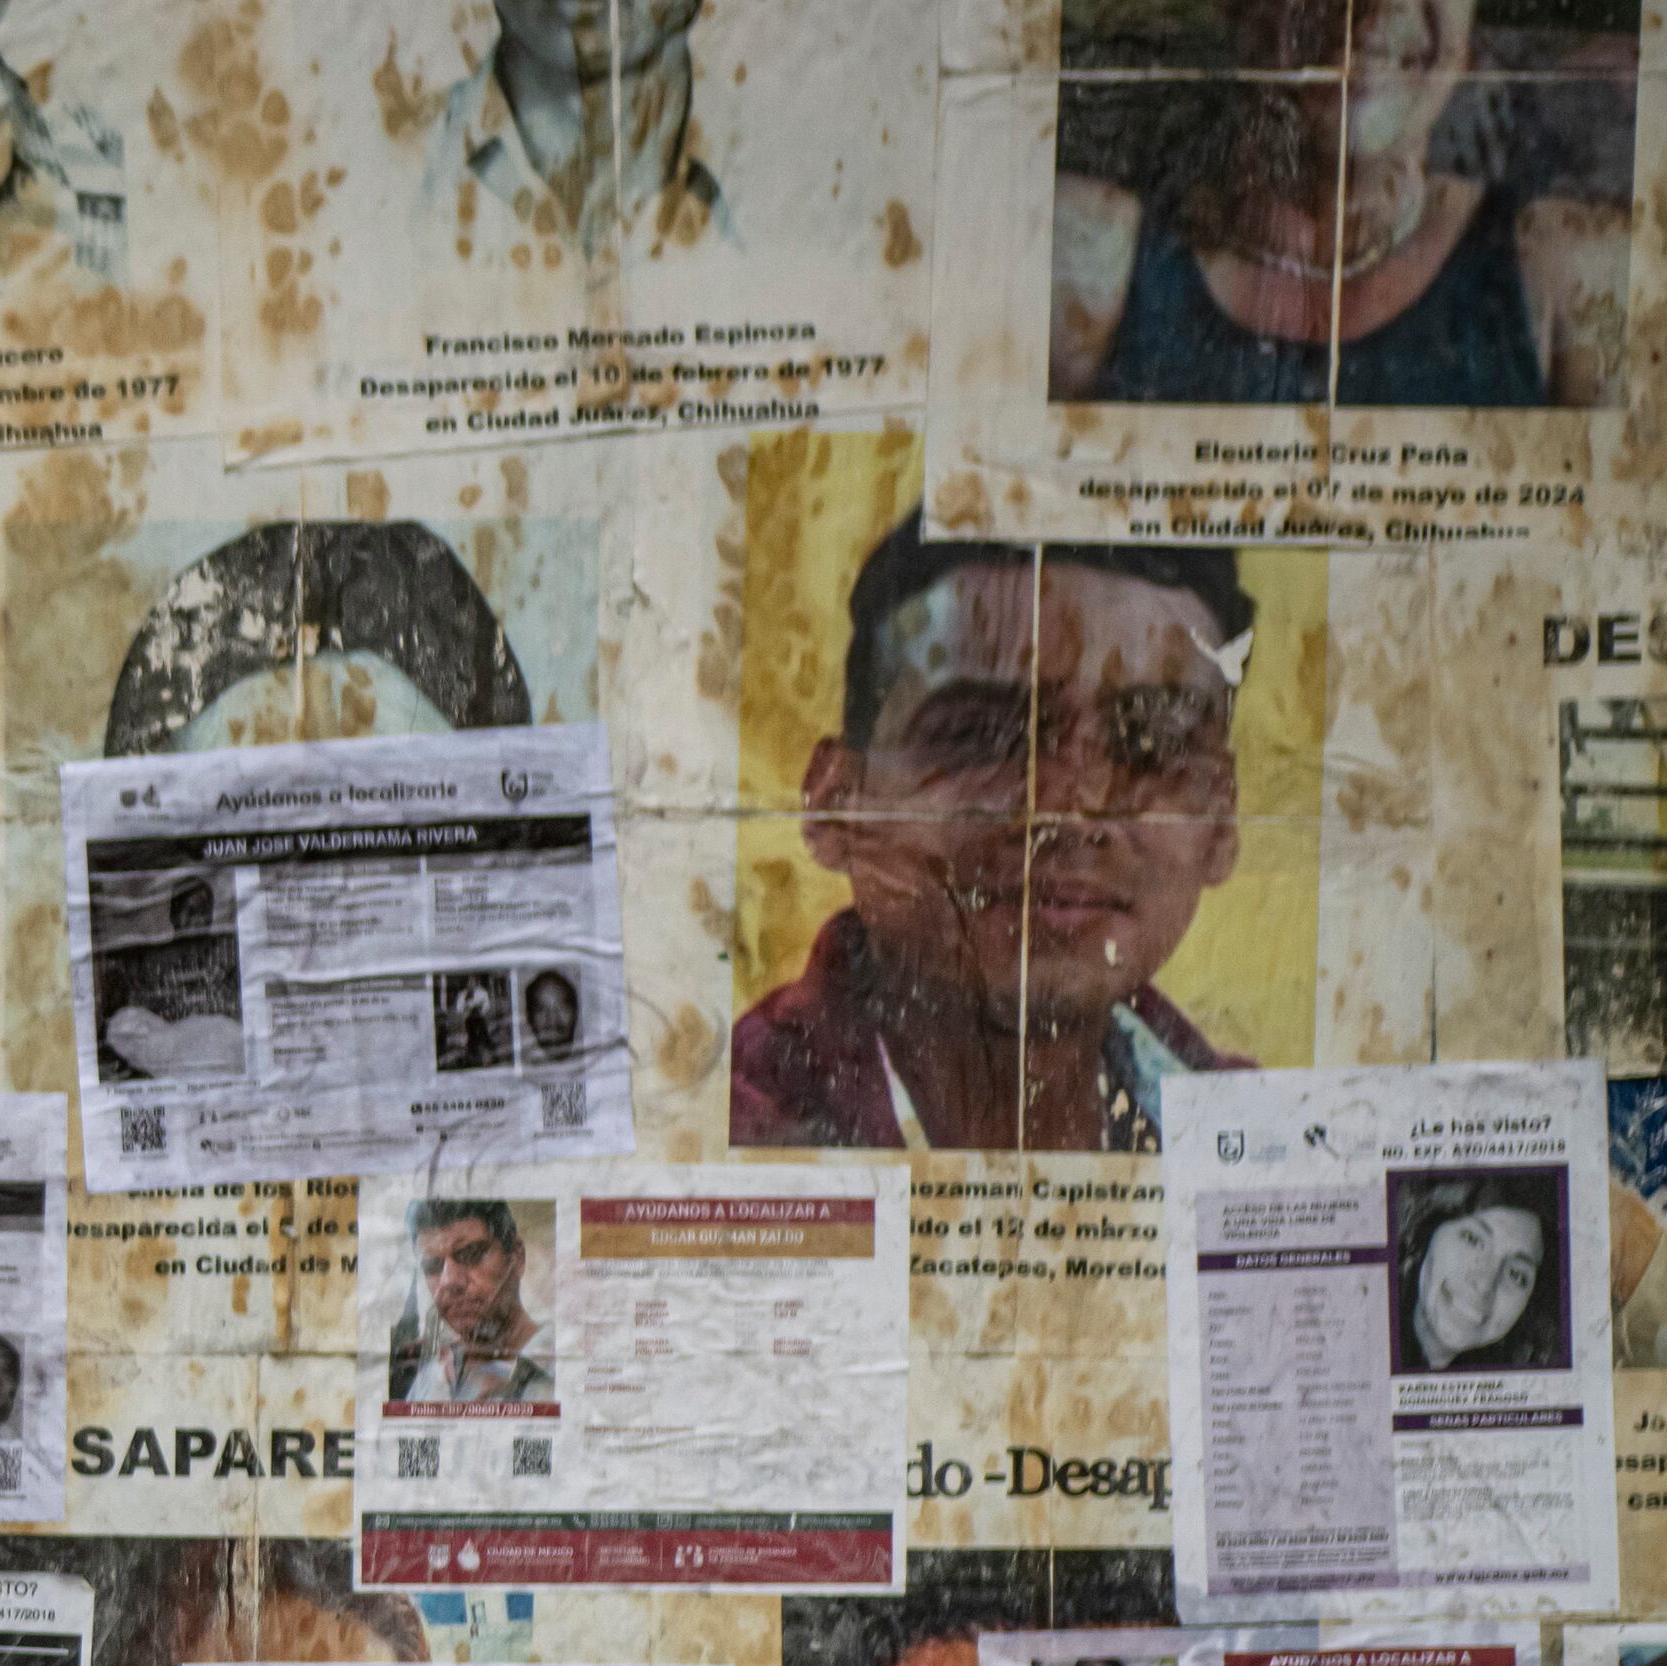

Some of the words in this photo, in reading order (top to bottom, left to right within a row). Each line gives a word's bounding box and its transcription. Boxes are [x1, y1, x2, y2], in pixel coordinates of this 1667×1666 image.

[425, 332, 559, 357] Francisco
[568, 327, 684, 352] Mercado
[695, 321, 816, 346] Espinoza
[425, 414, 458, 433] en
[467, 407, 560, 432] Ciudad
[677, 398, 820, 422] Chihuahua
[1401, 441, 1468, 466] Peña
[1079, 477, 1264, 505] desaparecido
[1351, 482, 1384, 503] de
[1392, 484, 1467, 509] mayo
[1475, 483, 1509, 505] de
[1518, 484, 1585, 506] 2024
[625, 1201, 711, 1221] AYÚDANOS
[714, 1204, 725, 1220] A
[729, 1203, 813, 1221] LOCALIZAR
[818, 1204, 831, 1220] A
[307, 1217, 339, 1234] de
[958, 1217, 981, 1236] el
[1035, 1219, 1066, 1238] de
[1076, 1215, 1158, 1240] marzo
[155, 1256, 186, 1275] en
[196, 1254, 287, 1275] Ciudad
[73, 1426, 355, 1478] SAPARE
